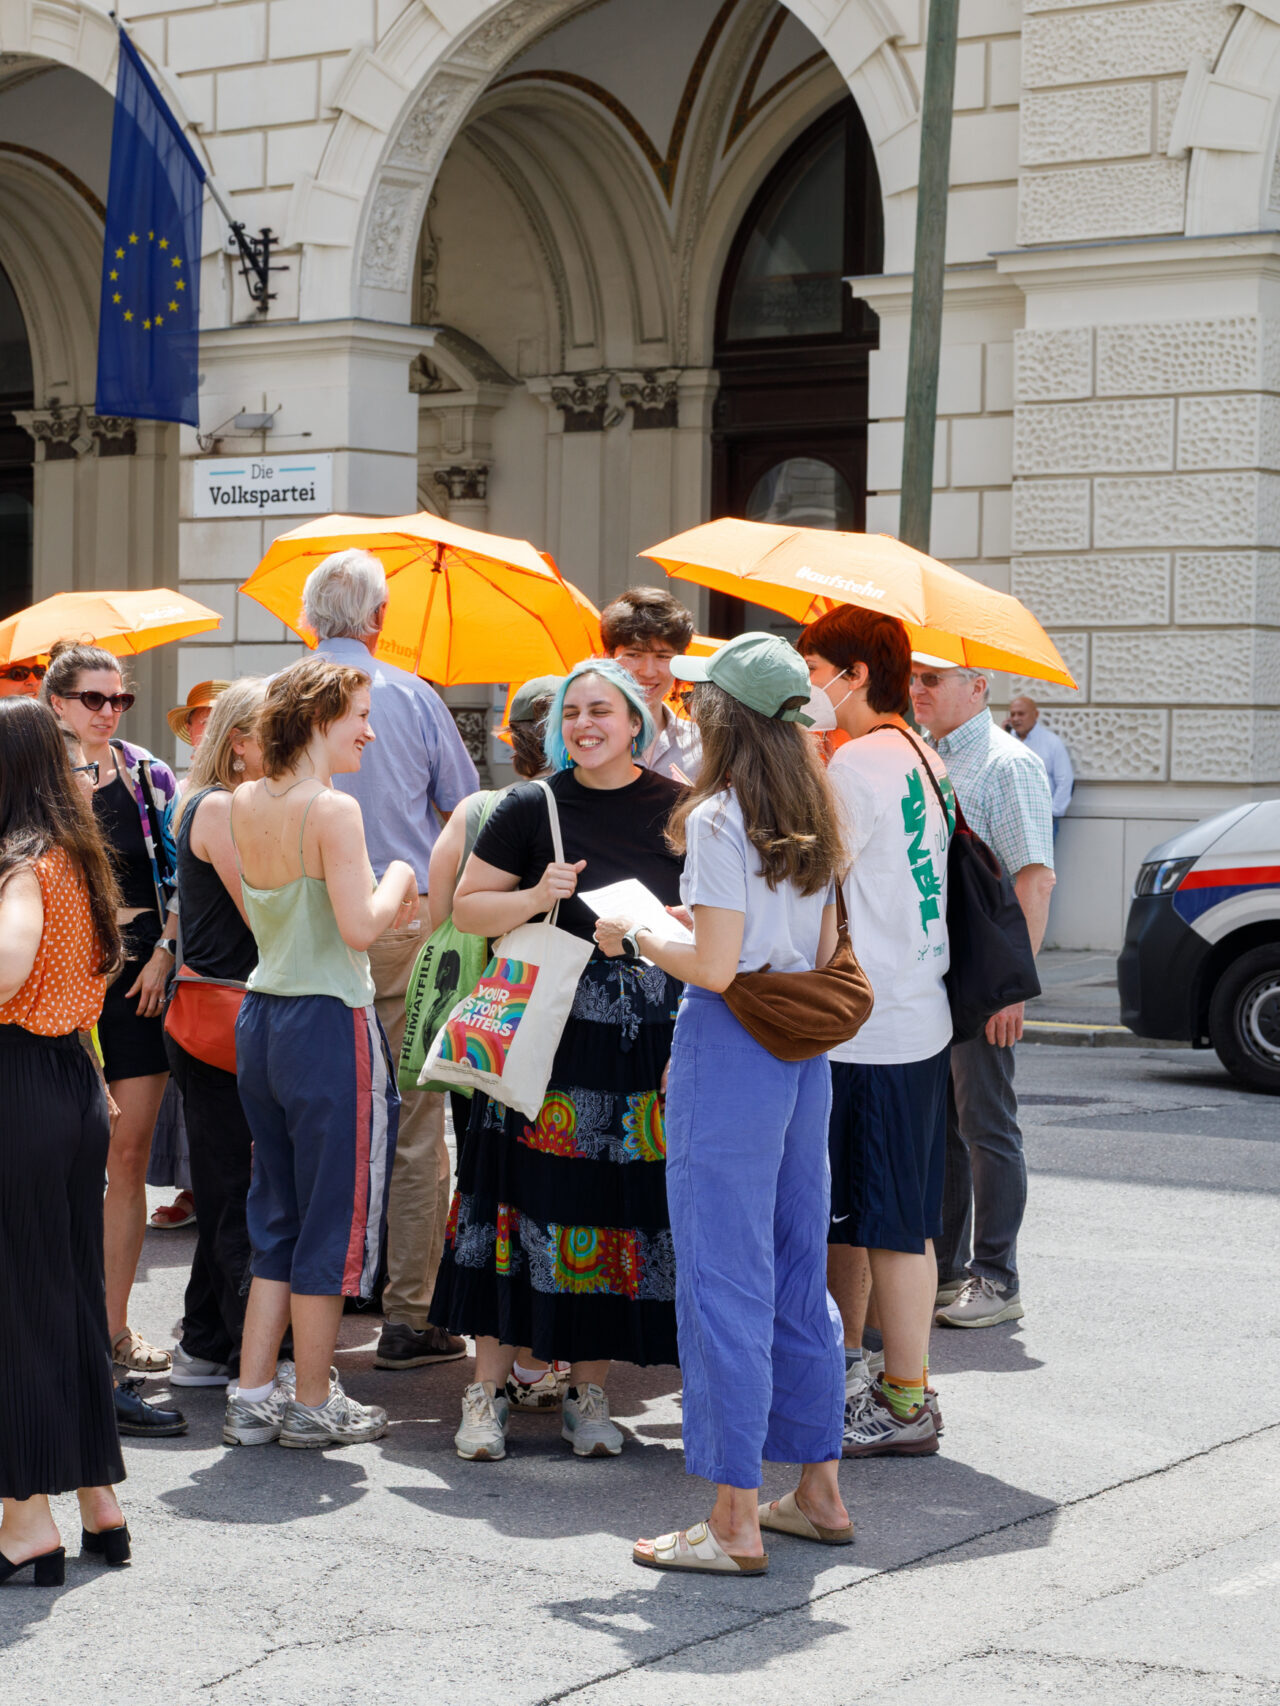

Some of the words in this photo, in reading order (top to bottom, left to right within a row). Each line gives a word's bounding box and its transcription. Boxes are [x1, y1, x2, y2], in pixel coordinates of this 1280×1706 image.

[251, 463, 274, 480] Die
[209, 481, 316, 508] Volkspartei
[402, 945, 435, 1061] HEIMATFILM
[477, 984, 510, 1004] YOUR
[464, 997, 509, 1019] STORY
[454, 1012, 513, 1037] ATTERS
